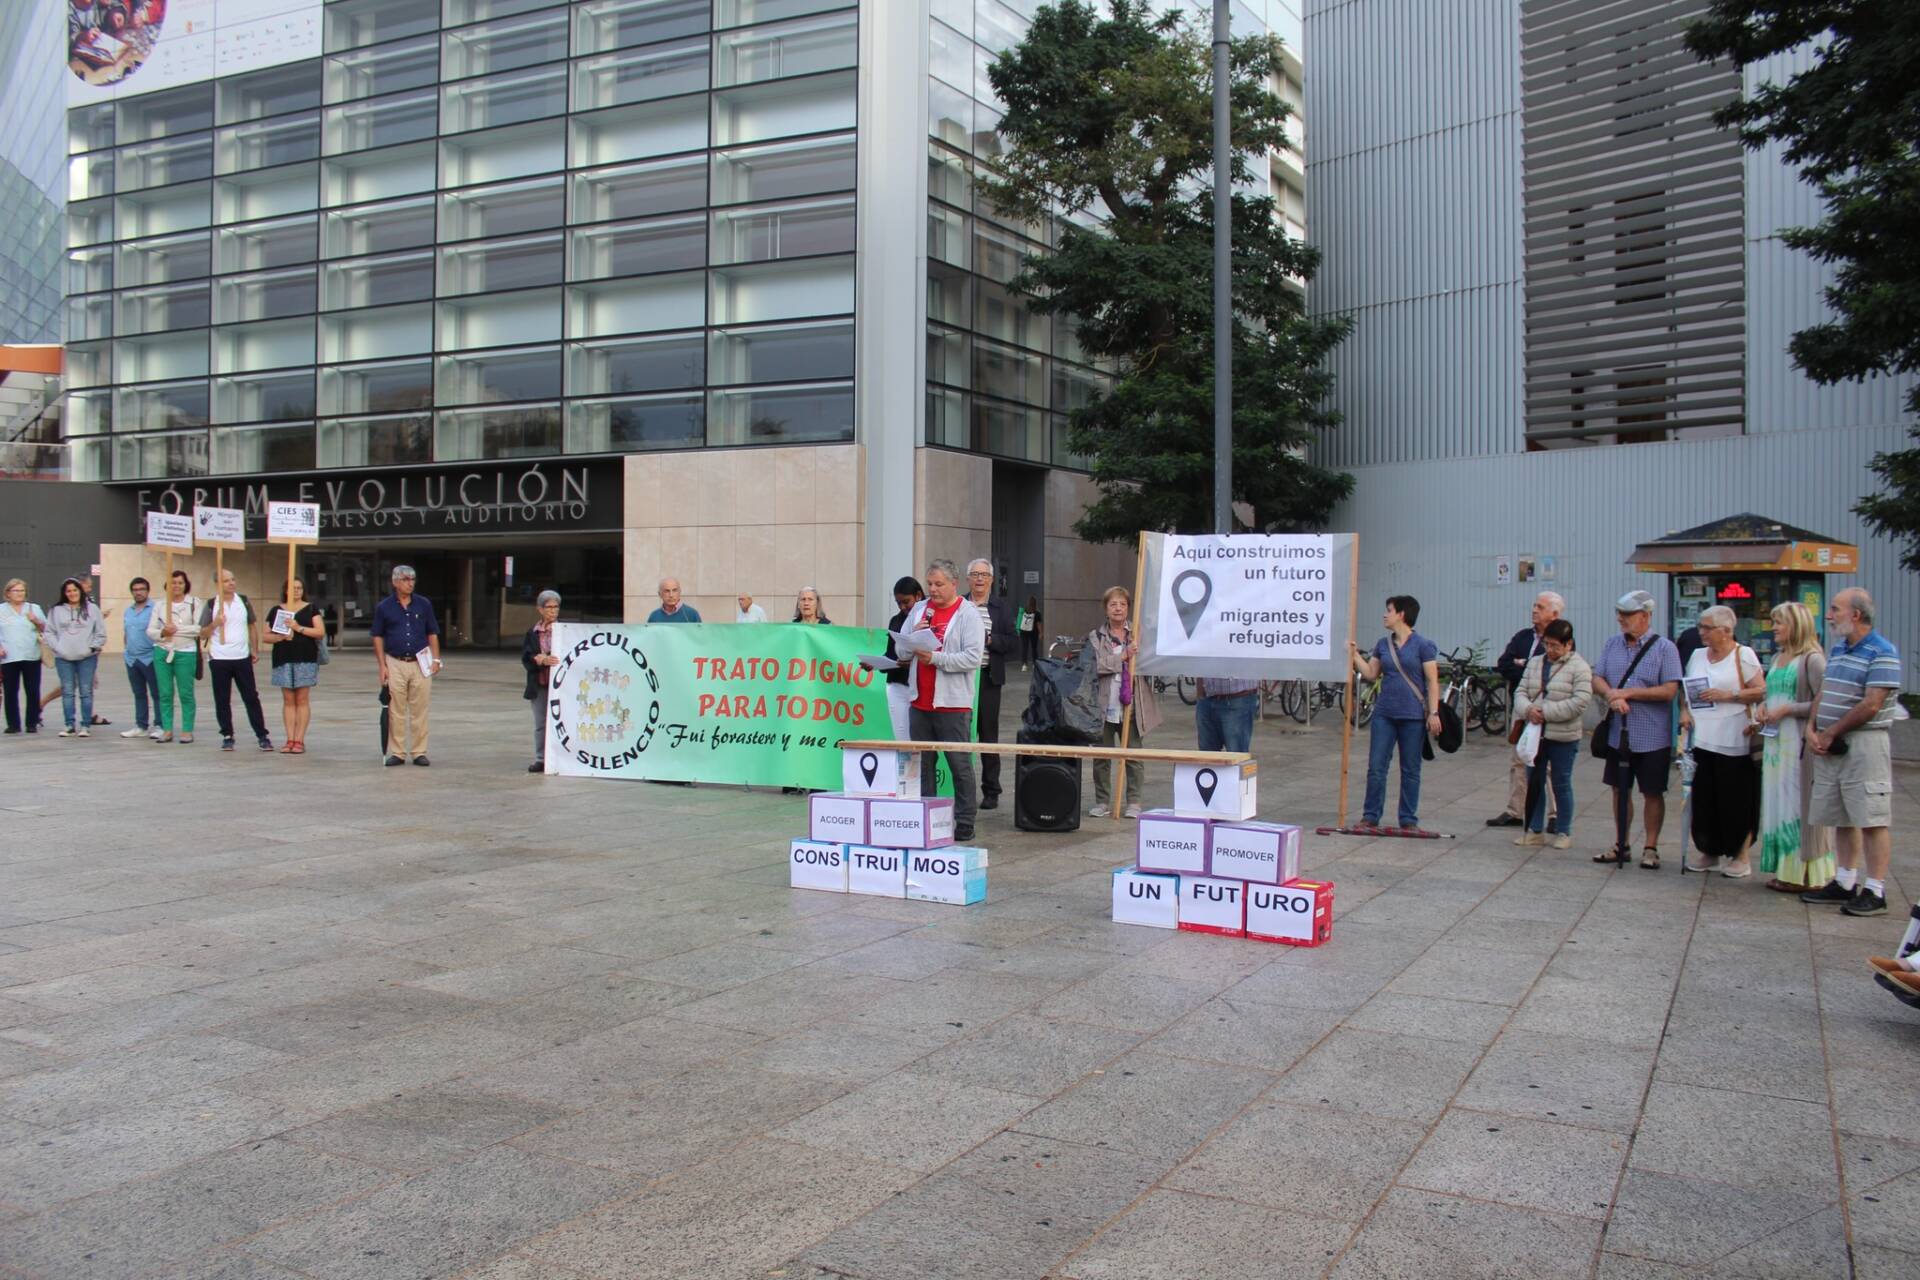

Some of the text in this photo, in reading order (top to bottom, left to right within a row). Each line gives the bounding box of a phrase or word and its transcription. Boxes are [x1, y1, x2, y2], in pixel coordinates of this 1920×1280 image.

[138, 463, 589, 516] FÓRUM EVOLUCIÓN
[276, 506, 298, 515] CIES
[319, 510, 402, 529] GRESOS
[419, 508, 428, 525] Y
[444, 502, 586, 524] AUDITORIO
[1216, 544, 1326, 560] construimos
[1244, 565, 1326, 581] un futuro
[1292, 590, 1326, 602] con
[1220, 608, 1325, 627] migrantes y
[1229, 630, 1325, 648] refugiados
[552, 631, 660, 694] CIRCULOS
[692, 656, 874, 688] TRATO DIGNO
[697, 693, 865, 726] PARA TODOS
[550, 698, 660, 770] DEL SILENCIO
[711, 725, 776, 750] forastero
[781, 733, 792, 752] y
[799, 734, 827, 749] me
[820, 816, 856, 825] ACOGER
[874, 819, 920, 829] PROTEGER
[1145, 839, 1198, 852] INTEGRAR
[1216, 846, 1275, 862] PROMOVER
[793, 848, 841, 867] CONS
[854, 853, 898, 872] TRUI
[913, 856, 960, 876] MOS
[1128, 881, 1161, 900] UN
[1193, 883, 1240, 904] FUT
[1254, 891, 1310, 914] URO
